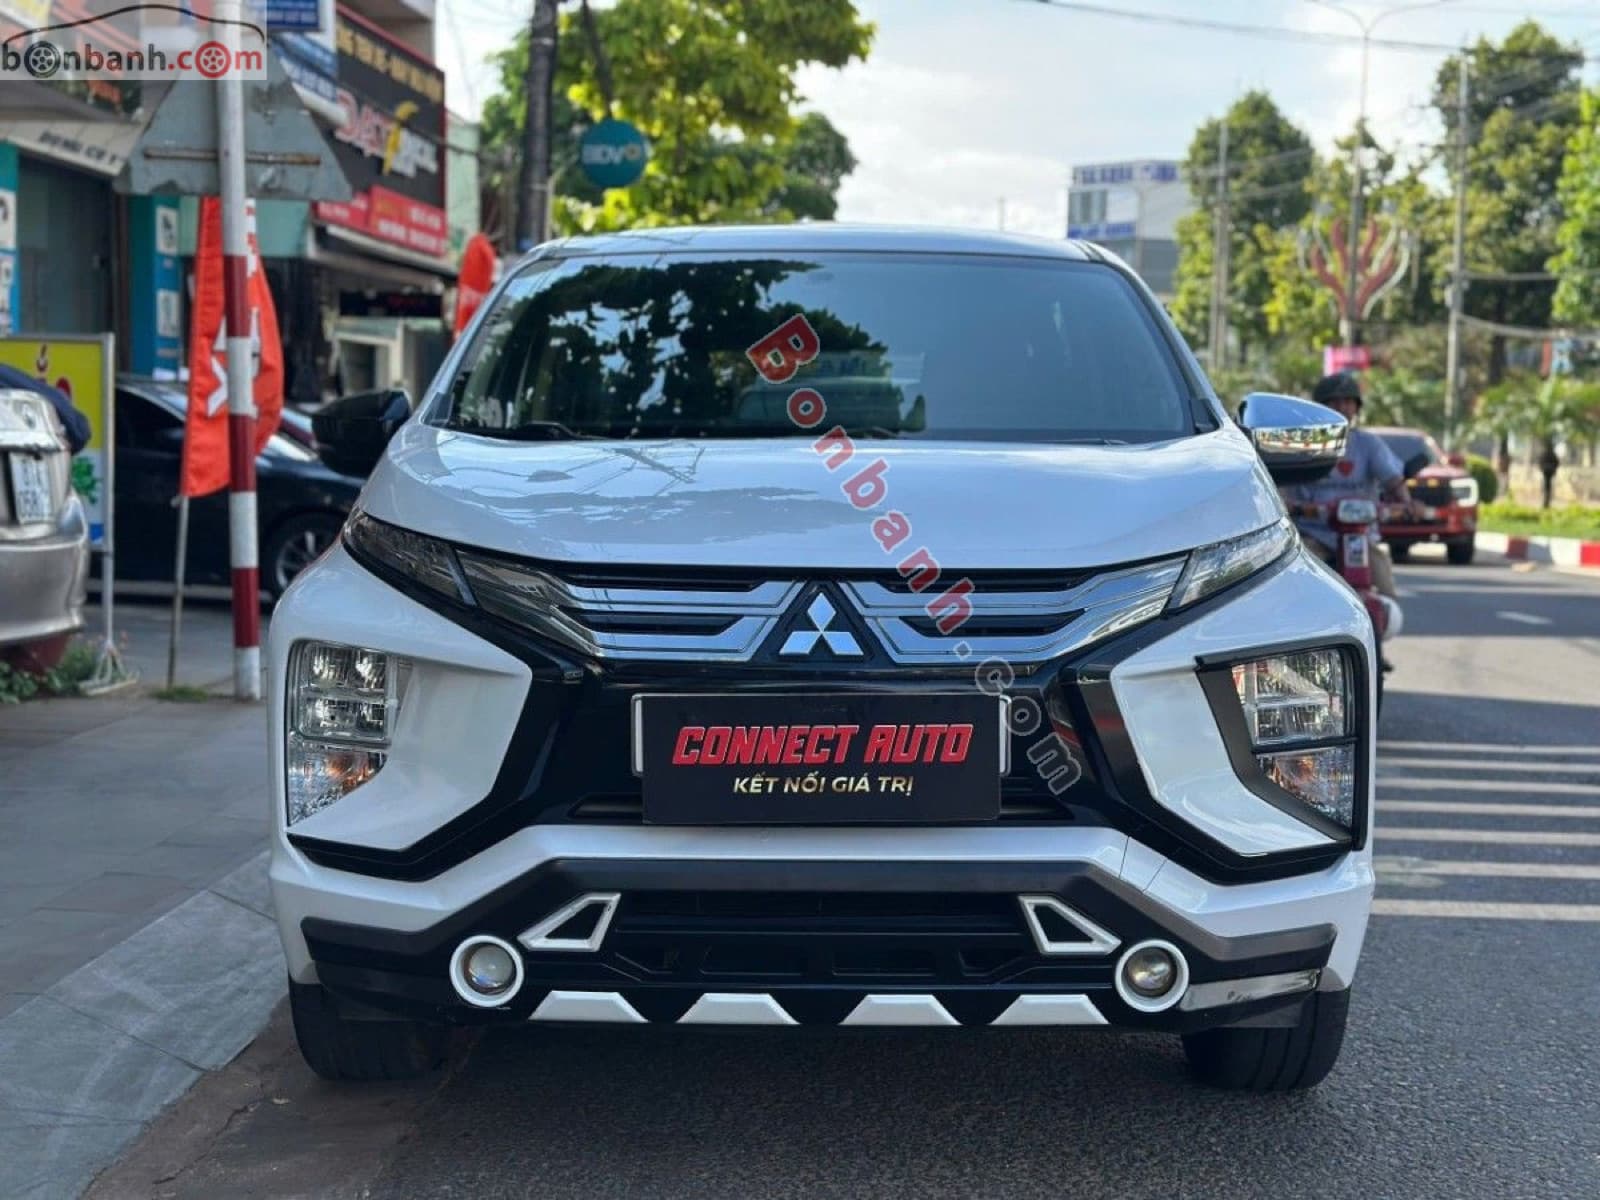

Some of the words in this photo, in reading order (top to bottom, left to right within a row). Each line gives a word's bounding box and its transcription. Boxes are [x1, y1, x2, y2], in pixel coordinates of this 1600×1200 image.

[672, 725, 859, 764] CONNECT
[865, 724, 973, 763] AUTO
[733, 771, 778, 793] KẾT
[783, 770, 825, 793] NỐI
[832, 774, 870, 793] GIÁ
[878, 775, 914, 796] TRỊ
